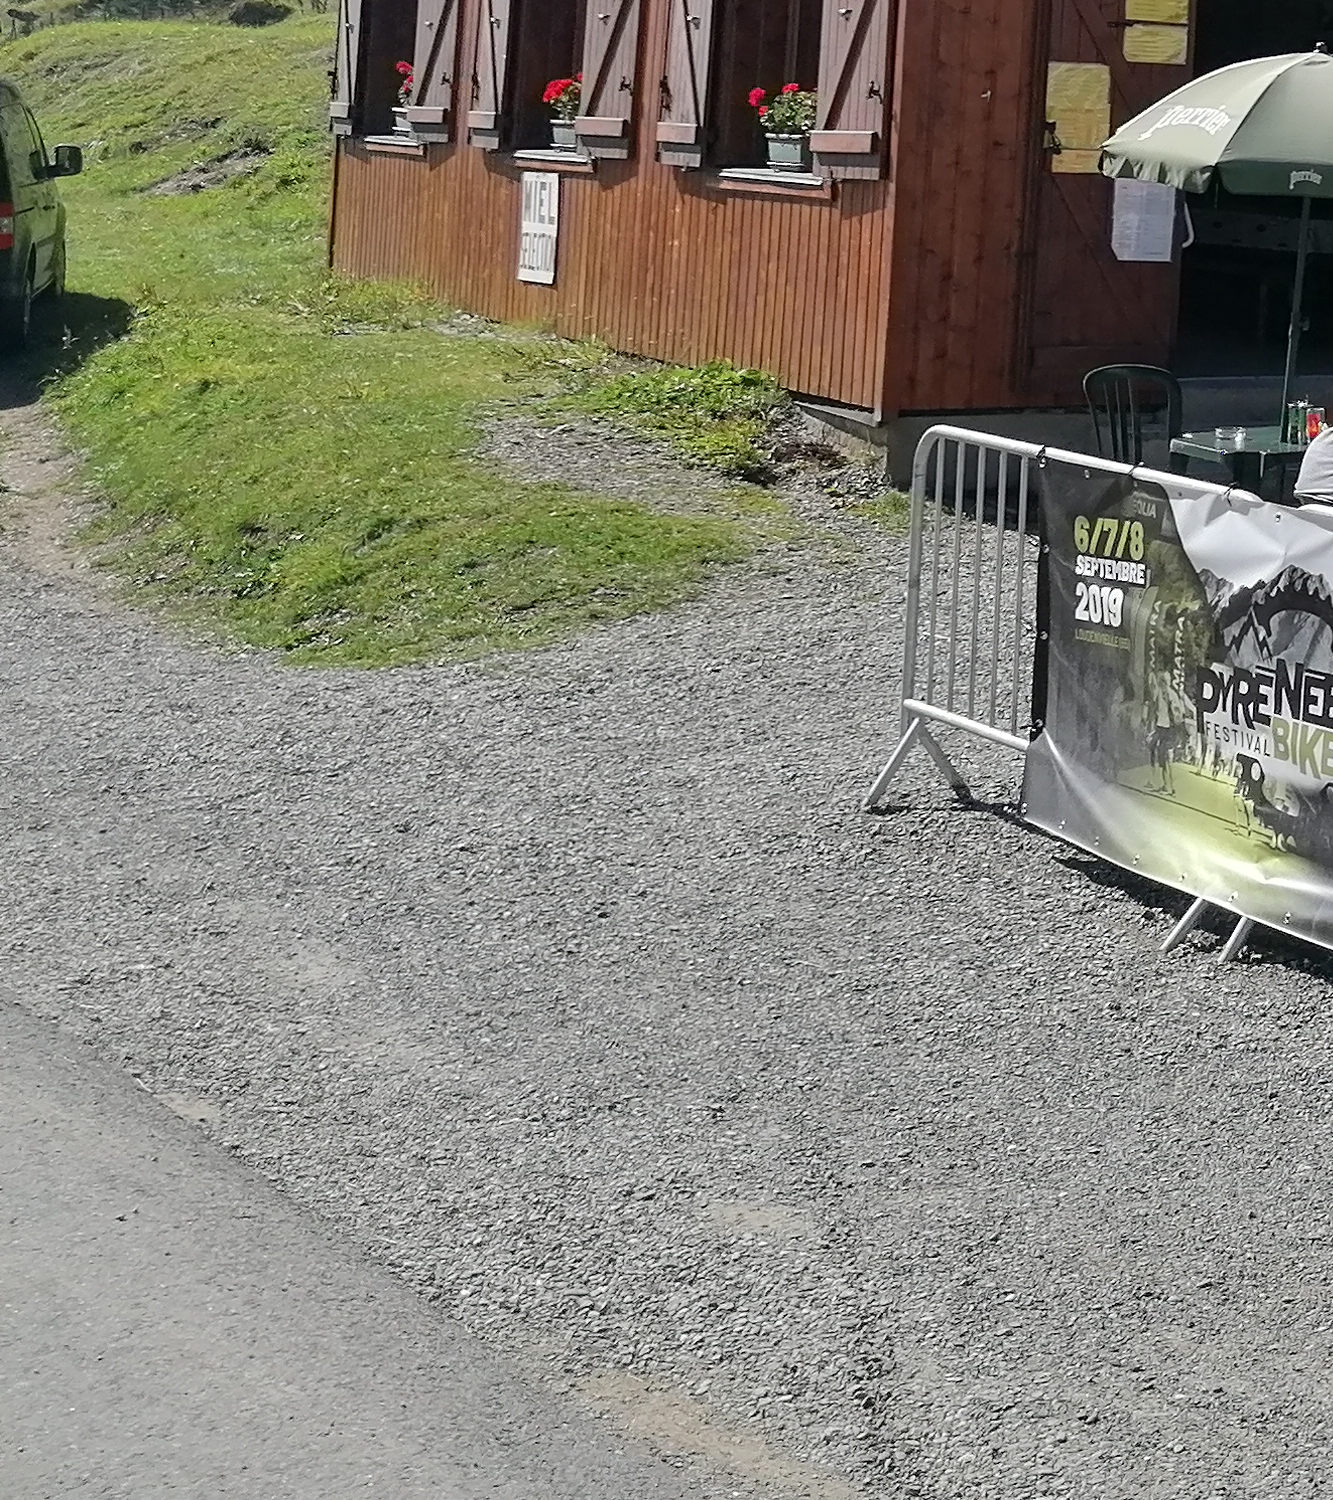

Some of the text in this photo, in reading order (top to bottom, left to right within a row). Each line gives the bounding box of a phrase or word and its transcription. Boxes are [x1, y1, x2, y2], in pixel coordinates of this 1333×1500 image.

[1074, 515, 1145, 561] 6/7/8
[1075, 554, 1146, 585] SEPTEMBRE
[1075, 582, 1124, 628] 2019
[1205, 721, 1271, 757] FESTIVAL
